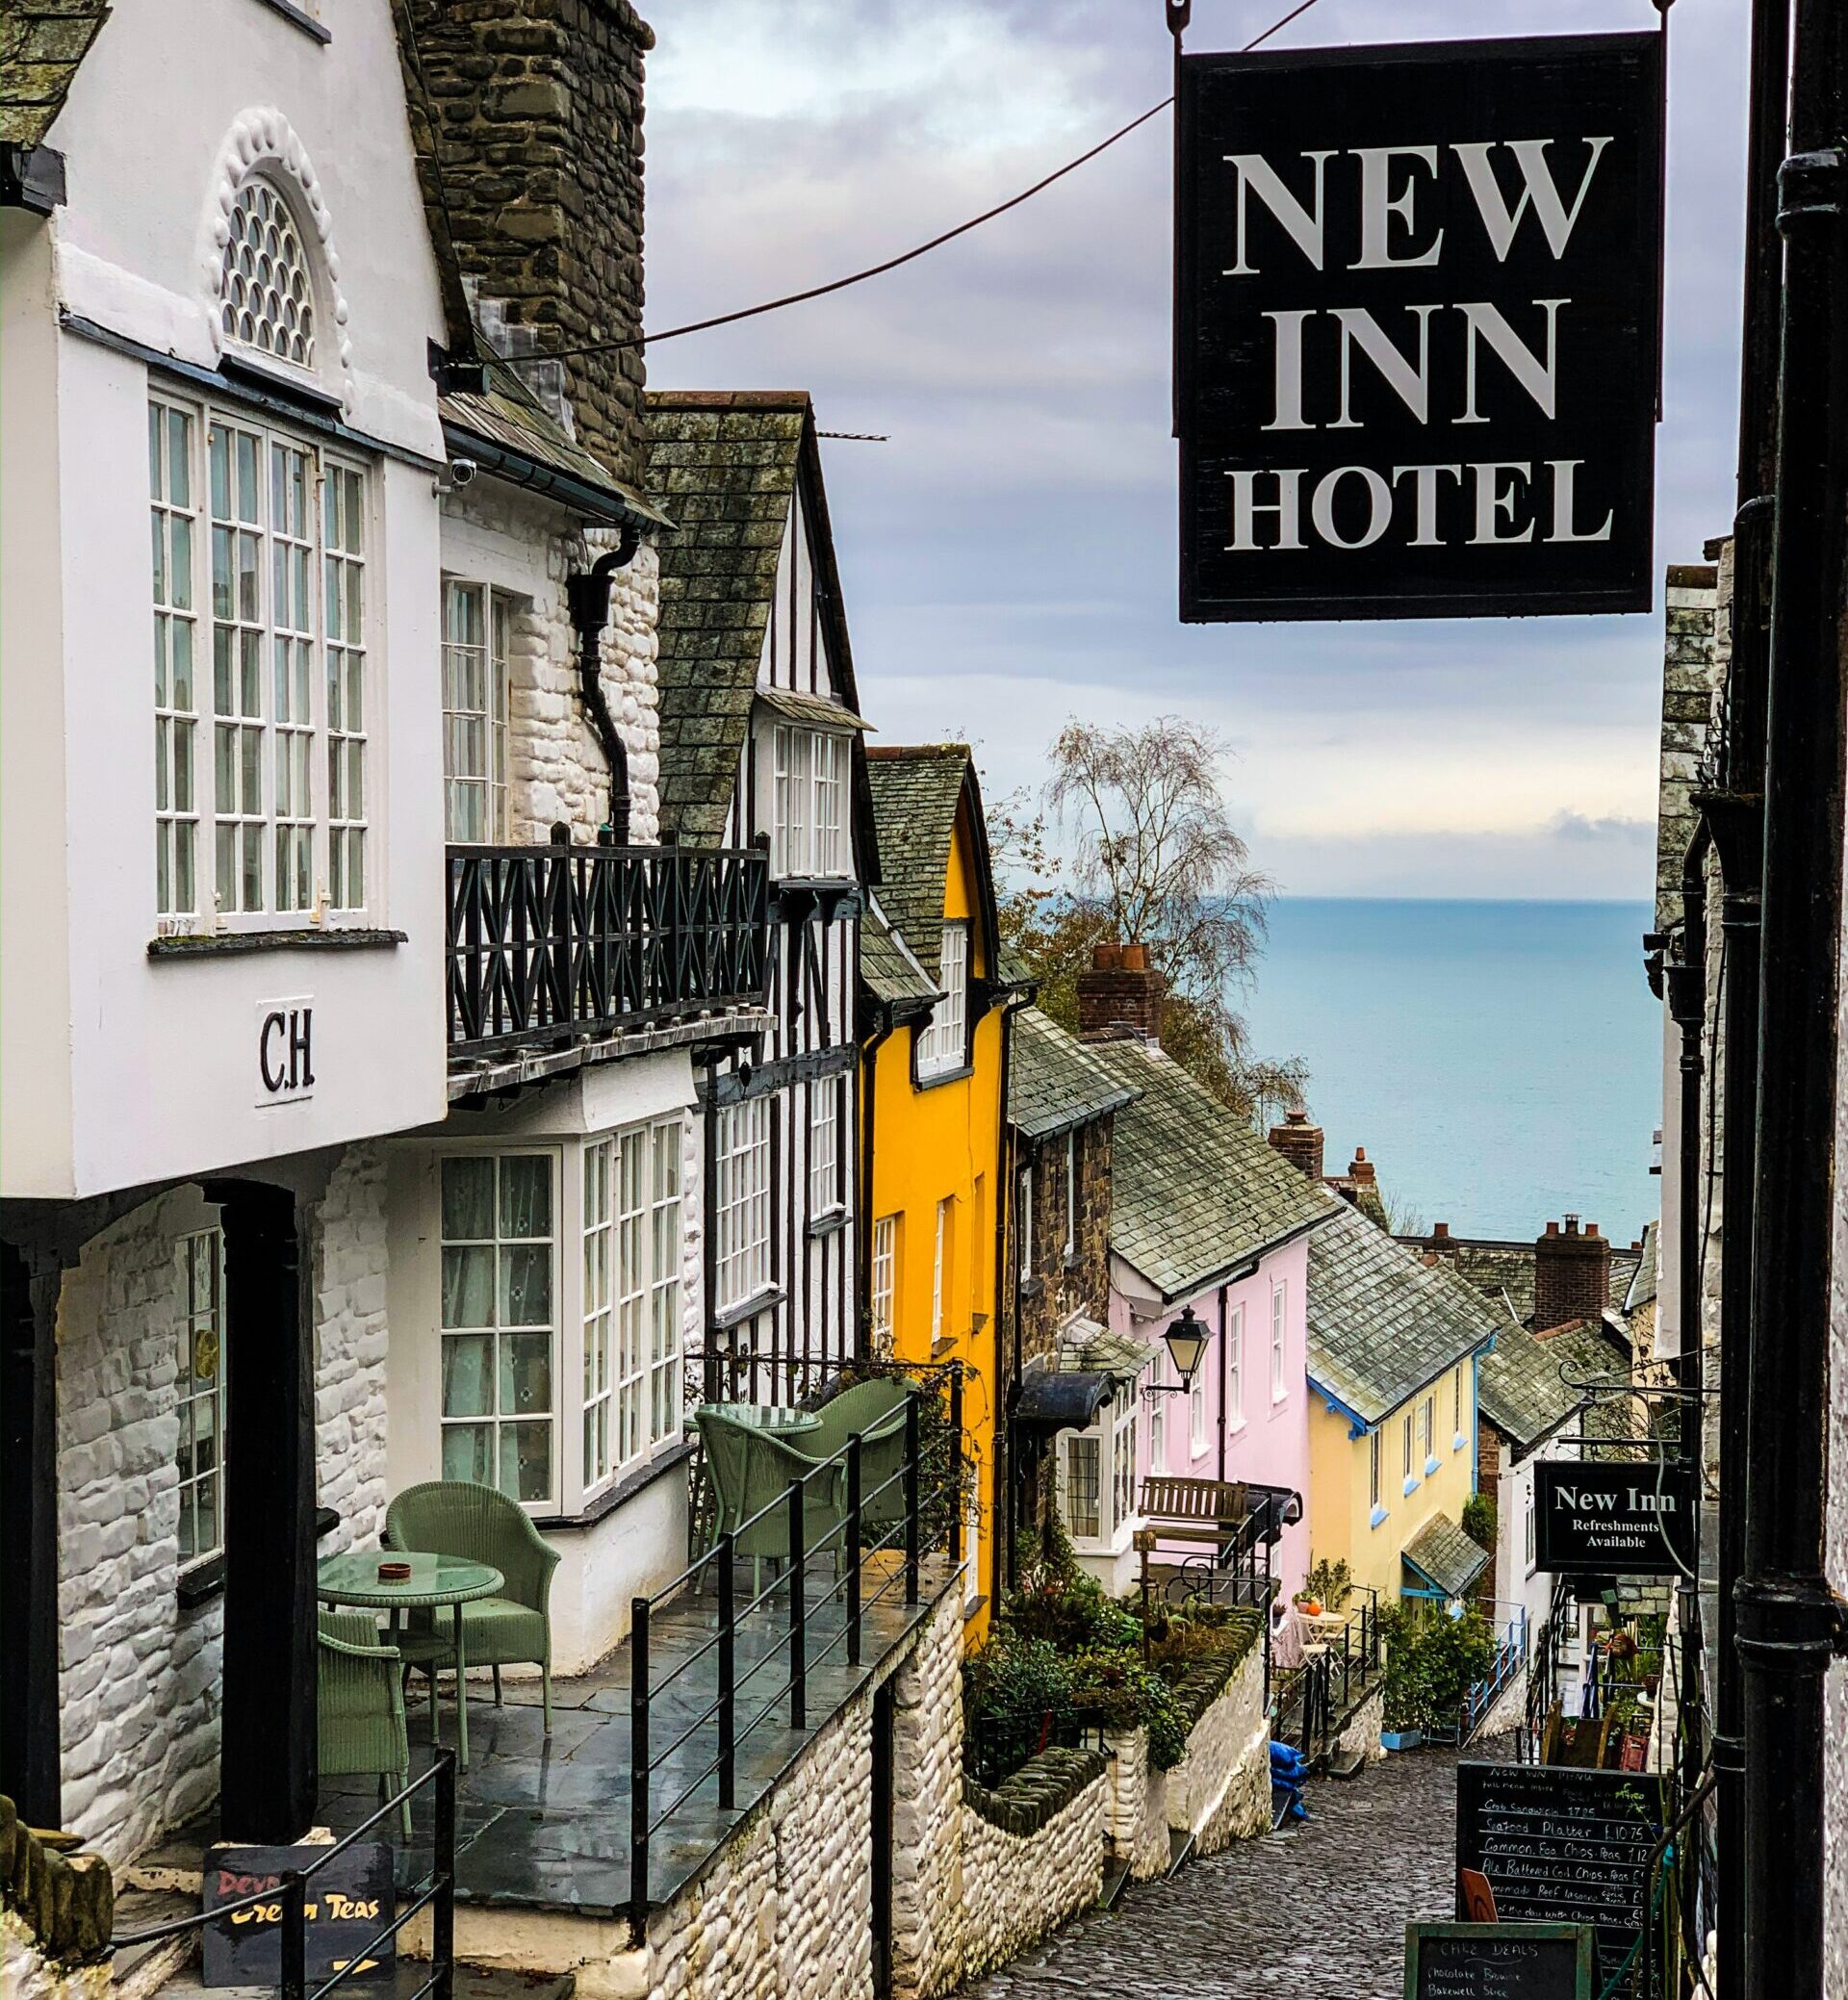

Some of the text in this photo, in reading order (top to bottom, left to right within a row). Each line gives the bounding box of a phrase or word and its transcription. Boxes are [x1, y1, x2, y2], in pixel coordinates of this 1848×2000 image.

[1221, 136, 1614, 276] NEW
[1260, 297, 1572, 431] INN
[1223, 458, 1614, 551] HOTEL
[1554, 1486, 1678, 1512] New Inn
[1572, 1519, 1659, 1532] Refreshments
[1586, 1535, 1646, 1548] Available
[1486, 1817, 1529, 1833] Seafood
[1542, 1821, 1592, 1839] Platter
[217, 1870, 281, 1896] Devo
[324, 1893, 380, 1920] Teas
[1491, 1942, 1539, 1957] DEALS
[1425, 1983, 1476, 1997] Bakewell
